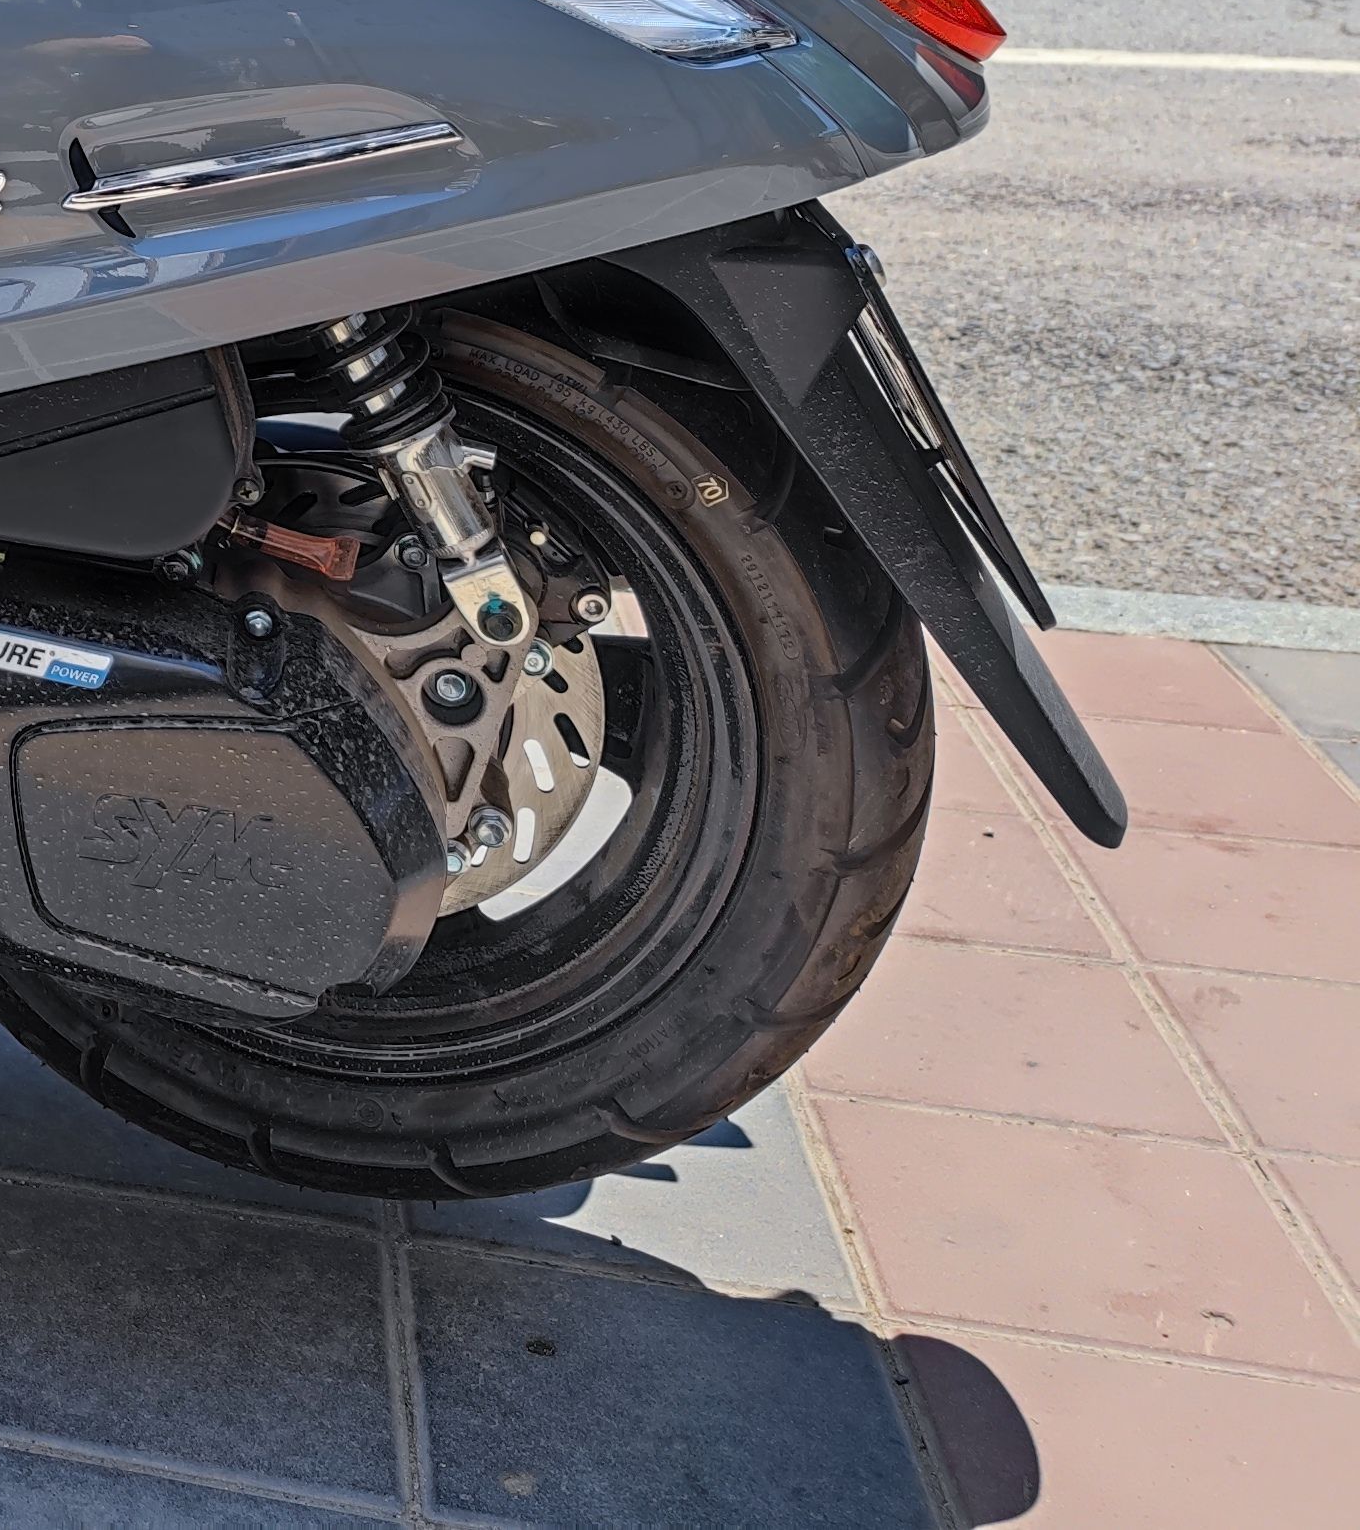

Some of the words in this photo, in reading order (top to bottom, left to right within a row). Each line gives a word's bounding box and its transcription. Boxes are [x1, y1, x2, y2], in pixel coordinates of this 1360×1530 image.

[697, 476, 723, 500] 70
[50, 664, 100, 685] POWER
[77, 791, 294, 890] SYM
